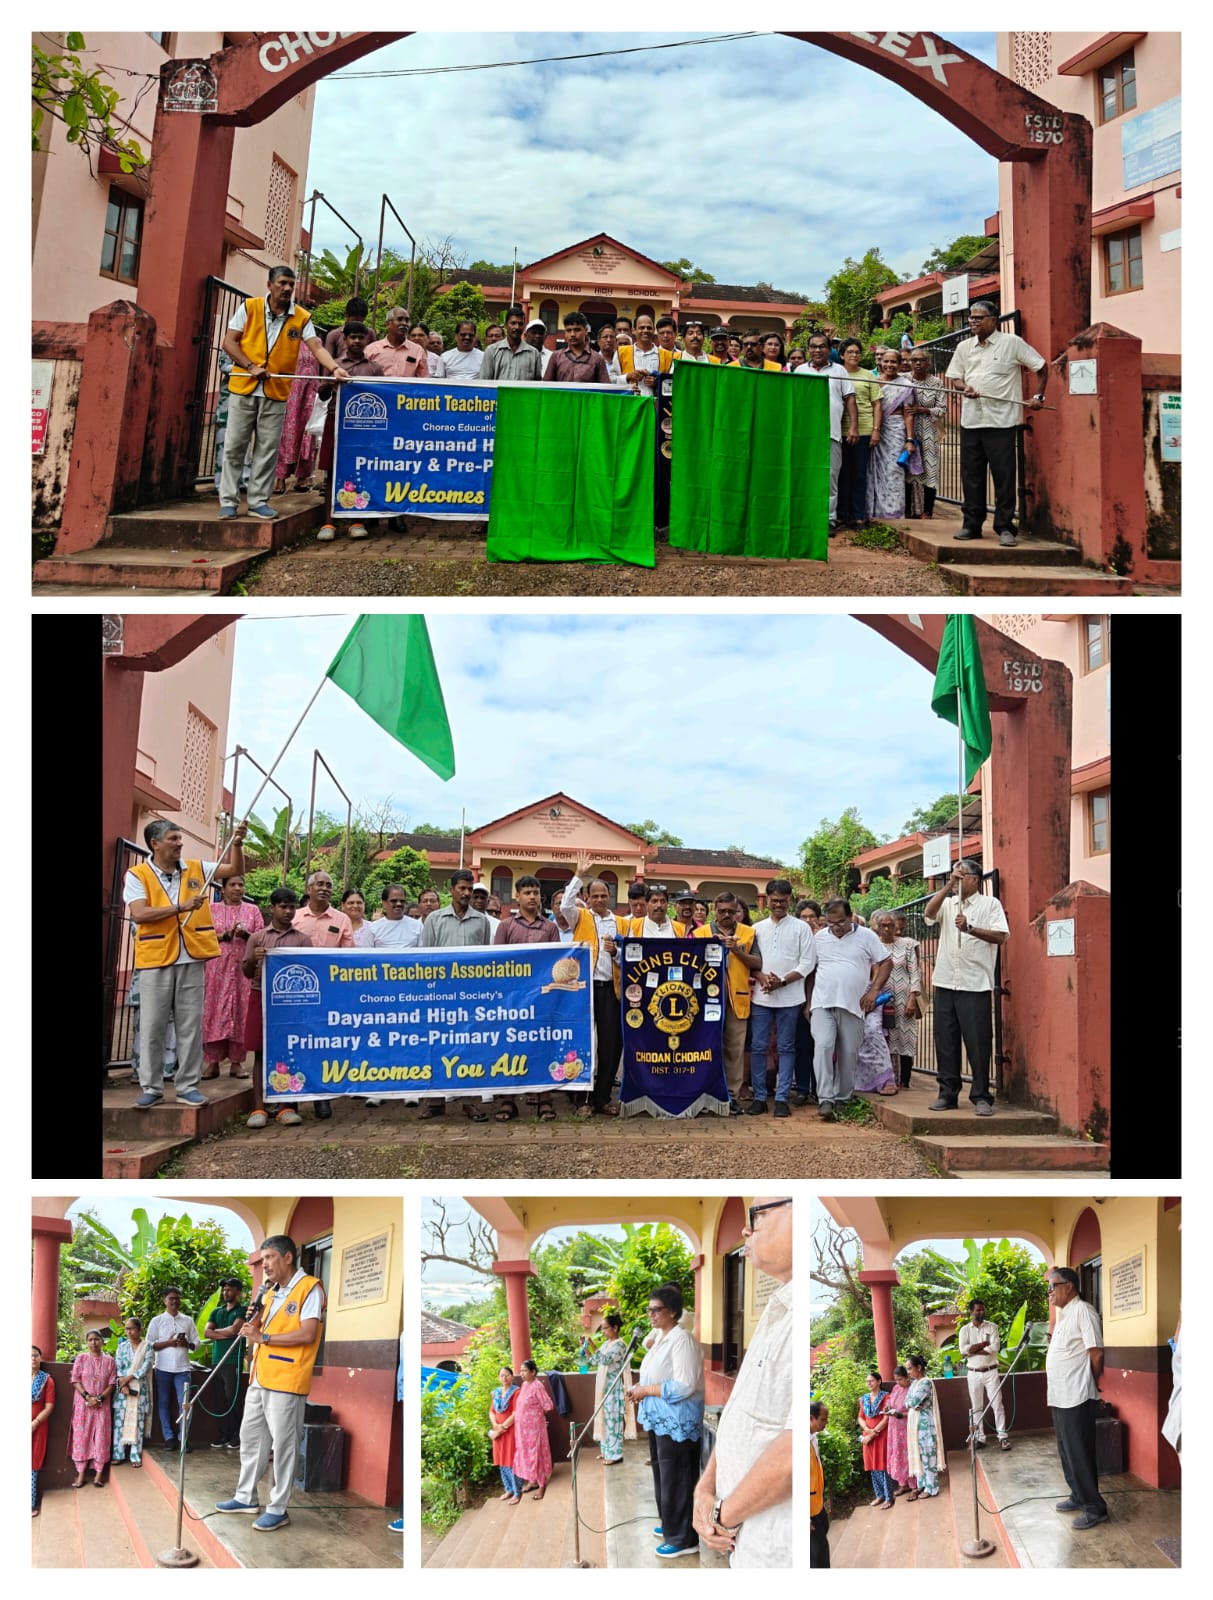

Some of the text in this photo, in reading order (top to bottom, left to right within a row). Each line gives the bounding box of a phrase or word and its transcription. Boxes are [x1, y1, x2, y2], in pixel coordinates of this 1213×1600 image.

[1029, 130, 1064, 144] 1970
[539, 283, 660, 297] DAYANAND HIGH SCHOOL
[397, 394, 440, 411] Parent
[422, 423, 456, 432] Chorao
[392, 436, 477, 454] Dayanand
[355, 456, 422, 474] Primary
[427, 458, 440, 472] &
[384, 481, 486, 505] Welcomes
[1003, 660, 1041, 675] ESTD
[1008, 677, 1043, 692] 1970
[490, 848, 624, 862] DAYANAND HIGH SCHOOL
[329, 960, 532, 982] Parent Teachers Association
[627, 951, 673, 984] LIONS
[359, 990, 504, 1003] Chorao Educational Society's
[659, 983, 691, 996] LIONS
[669, 997, 684, 1017] L
[327, 1005, 535, 1028] Dayanand High School
[287, 1026, 573, 1051] Primary & Pre-Primary Section
[635, 1052, 671, 1063] CHODAN
[321, 1052, 529, 1084] Welcomes You All
